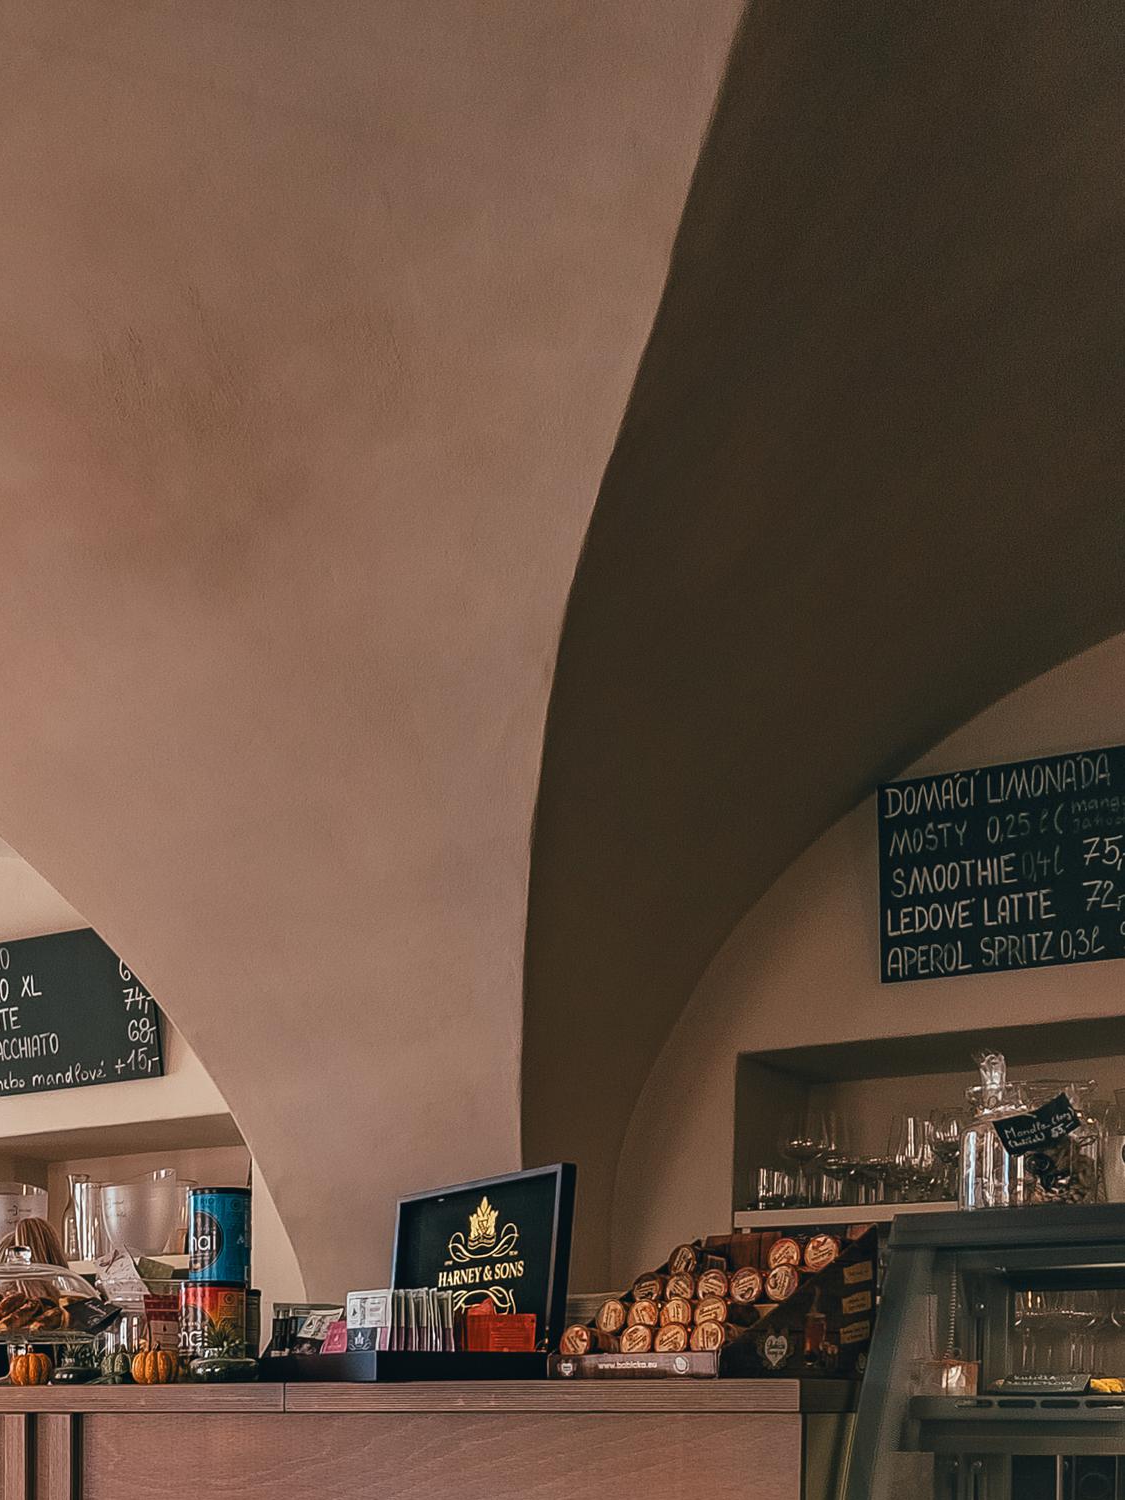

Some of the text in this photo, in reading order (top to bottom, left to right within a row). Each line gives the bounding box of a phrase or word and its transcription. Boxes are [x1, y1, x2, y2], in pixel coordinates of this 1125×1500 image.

[891, 852, 1018, 898] SMOOTHIE
[983, 888, 1056, 926] LATTE
[887, 940, 972, 978] APEROL
[980, 931, 1055, 966] SPRITZ
[20, 974, 43, 998] XL
[438, 1260, 525, 1288] HARNEY & SONS
